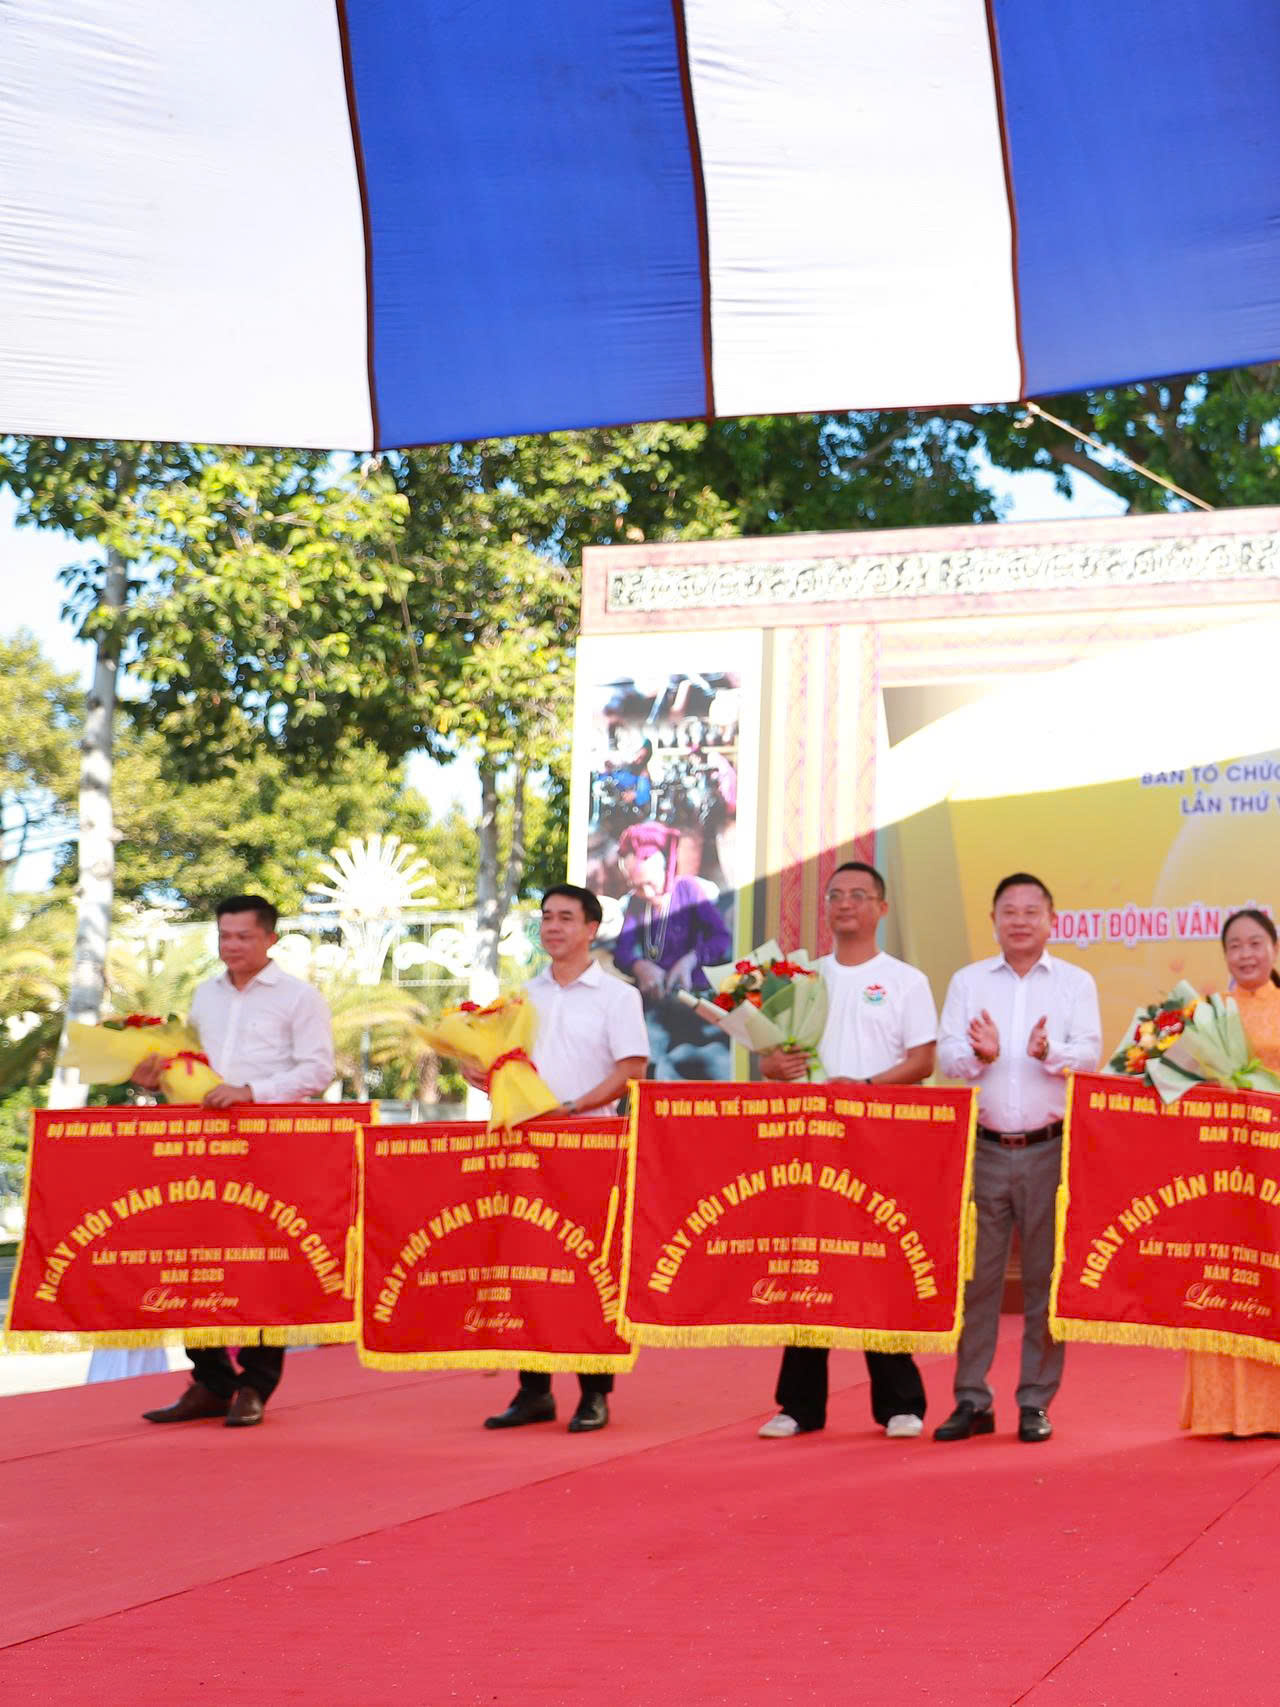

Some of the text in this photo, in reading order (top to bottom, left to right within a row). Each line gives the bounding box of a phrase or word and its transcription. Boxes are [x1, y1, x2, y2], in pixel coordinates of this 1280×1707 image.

[1181, 789, 1222, 815] LẦN
[1229, 791, 1271, 813] THỨ
[1109, 905, 1169, 945] ĐỘNG
[1176, 903, 1220, 936] VĂN
[69, 1209, 113, 1249] HỘI
[112, 1187, 163, 1221] VĂN
[168, 1174, 217, 1203] HÓA
[223, 1181, 271, 1213] DÂN
[268, 1200, 309, 1239] TỘC
[428, 1202, 474, 1239] VĂN
[511, 1194, 559, 1231] DÂN
[556, 1218, 595, 1260] TỘC
[648, 1157, 939, 1300] NGÀY HỘI VĂN HÓA DÂN TỘC CHĂM
[1080, 1223, 1126, 1290] NGÀY
[1118, 1194, 1161, 1235] HỘI
[1158, 1174, 1209, 1209] VĂN
[1213, 1165, 1256, 1196] HÓA
